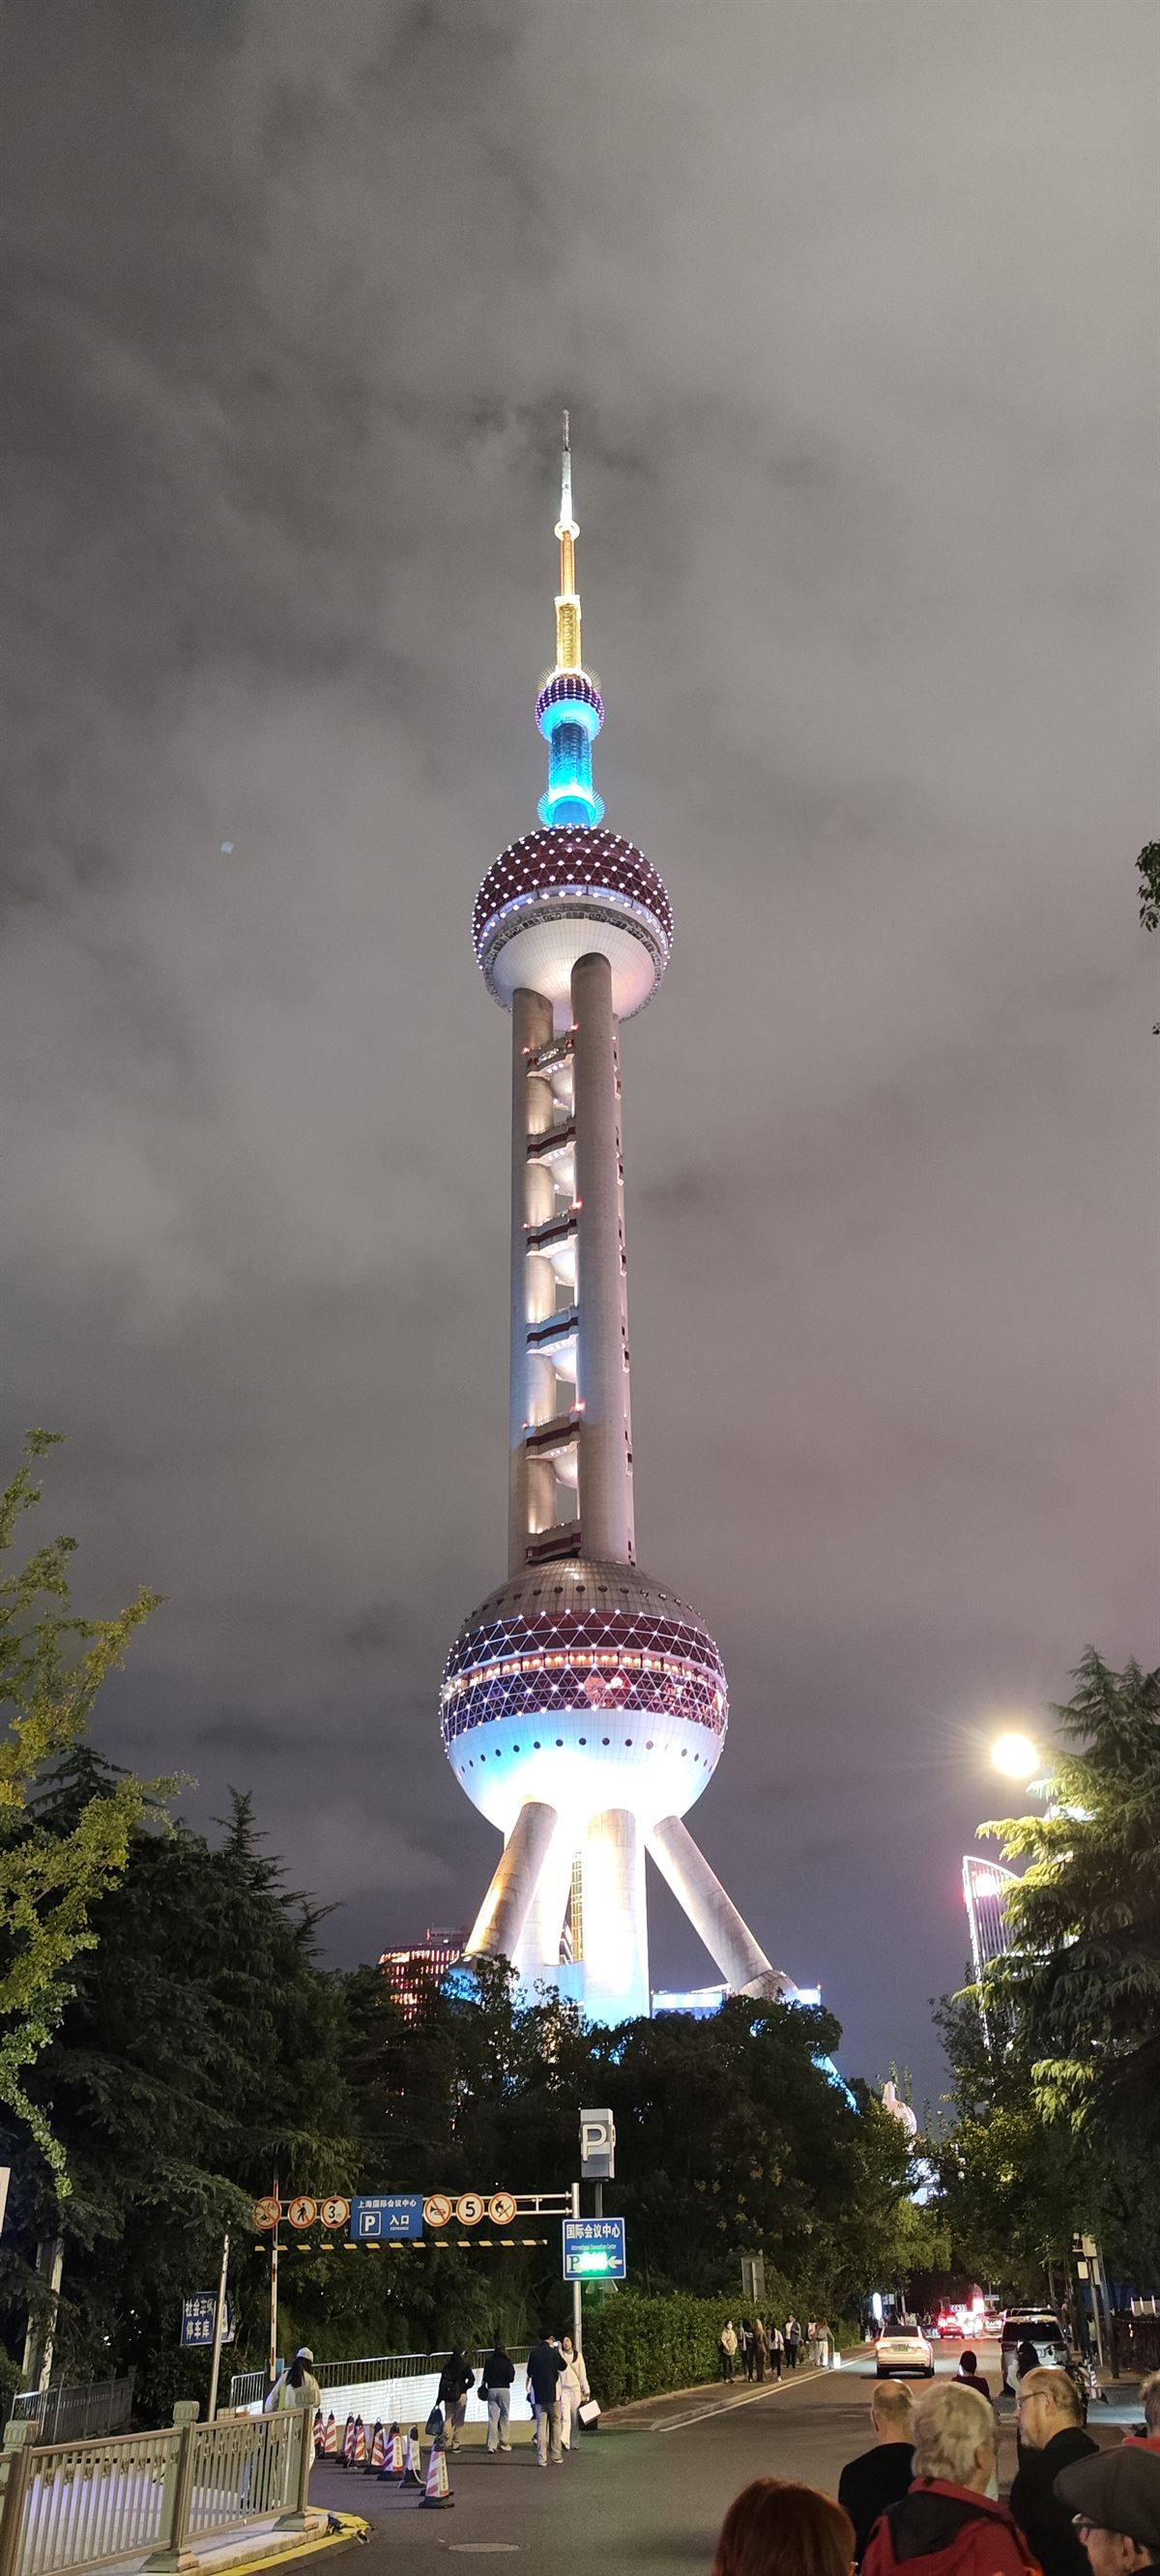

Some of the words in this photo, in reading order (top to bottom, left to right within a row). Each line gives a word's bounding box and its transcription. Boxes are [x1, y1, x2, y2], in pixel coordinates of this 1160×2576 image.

[583, 2124, 607, 2160] P
[358, 2199, 417, 2209] 上海国际会议中心
[466, 2201, 475, 2217] 5
[364, 2215, 375, 2232] P
[390, 2214, 409, 2225] 入口
[566, 2223, 621, 2239] 国际会议中心
[568, 2255, 580, 2272] P
[187, 2319, 210, 2339] 停车库
